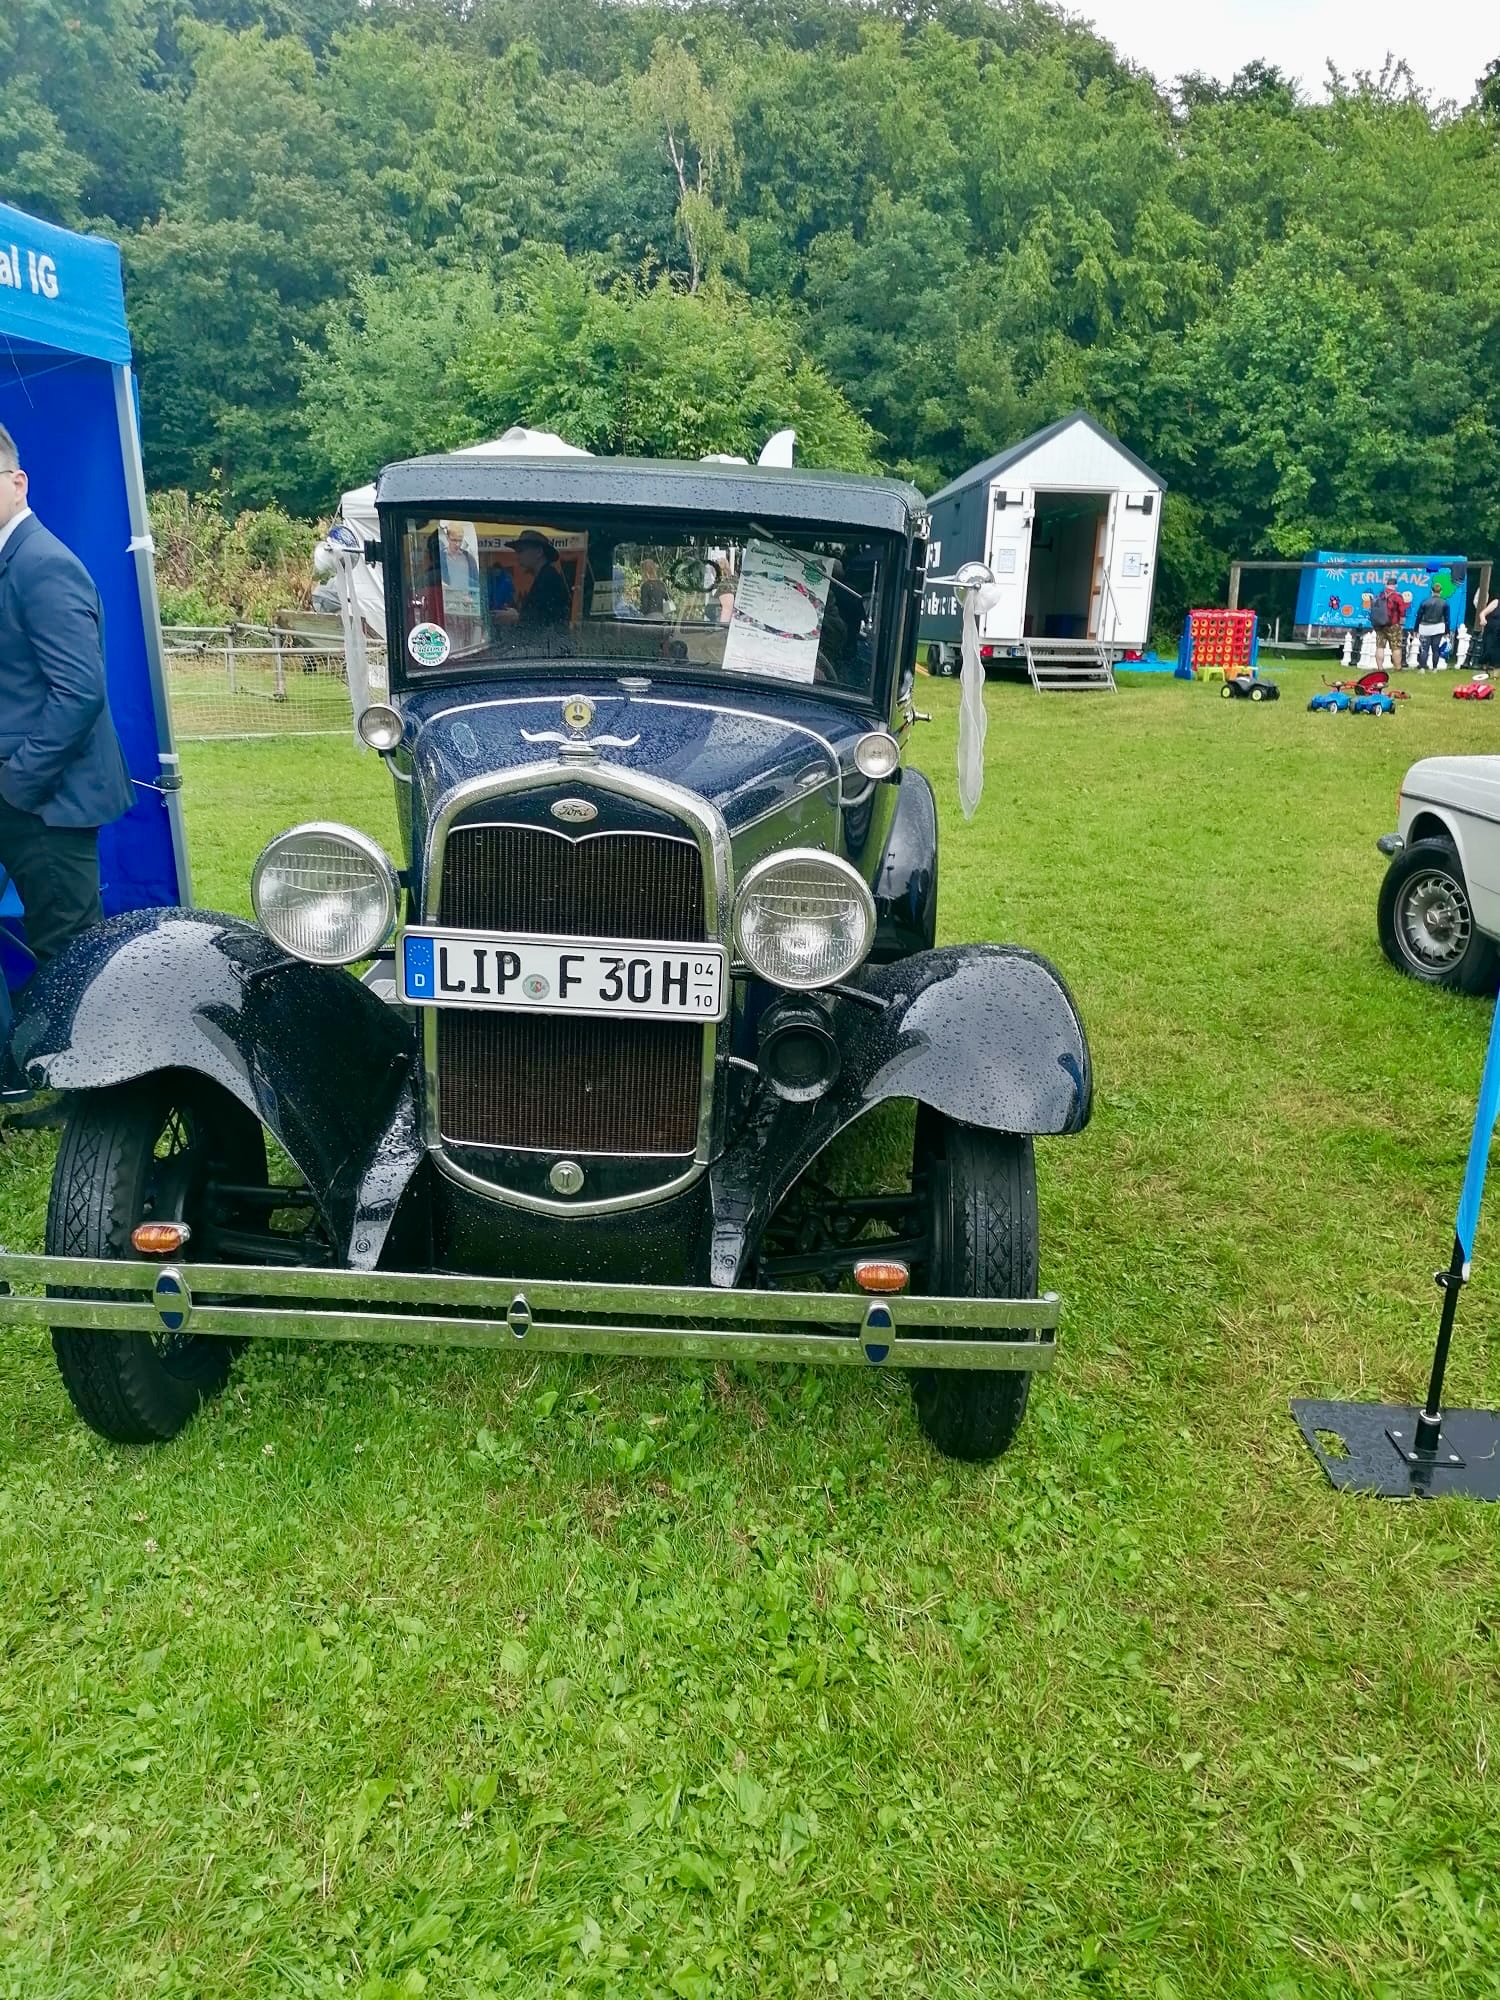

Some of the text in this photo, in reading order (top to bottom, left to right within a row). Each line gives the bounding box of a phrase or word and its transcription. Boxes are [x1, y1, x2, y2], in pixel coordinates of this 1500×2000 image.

[28, 250, 59, 299] IG
[1350, 570, 1430, 587] FIRLEFANZ
[557, 803, 590, 816] Ford
[439, 946, 689, 1006] LIP F 30H
[694, 962, 714, 976] 04
[414, 973, 425, 987] D
[694, 993, 712, 1008] 10
